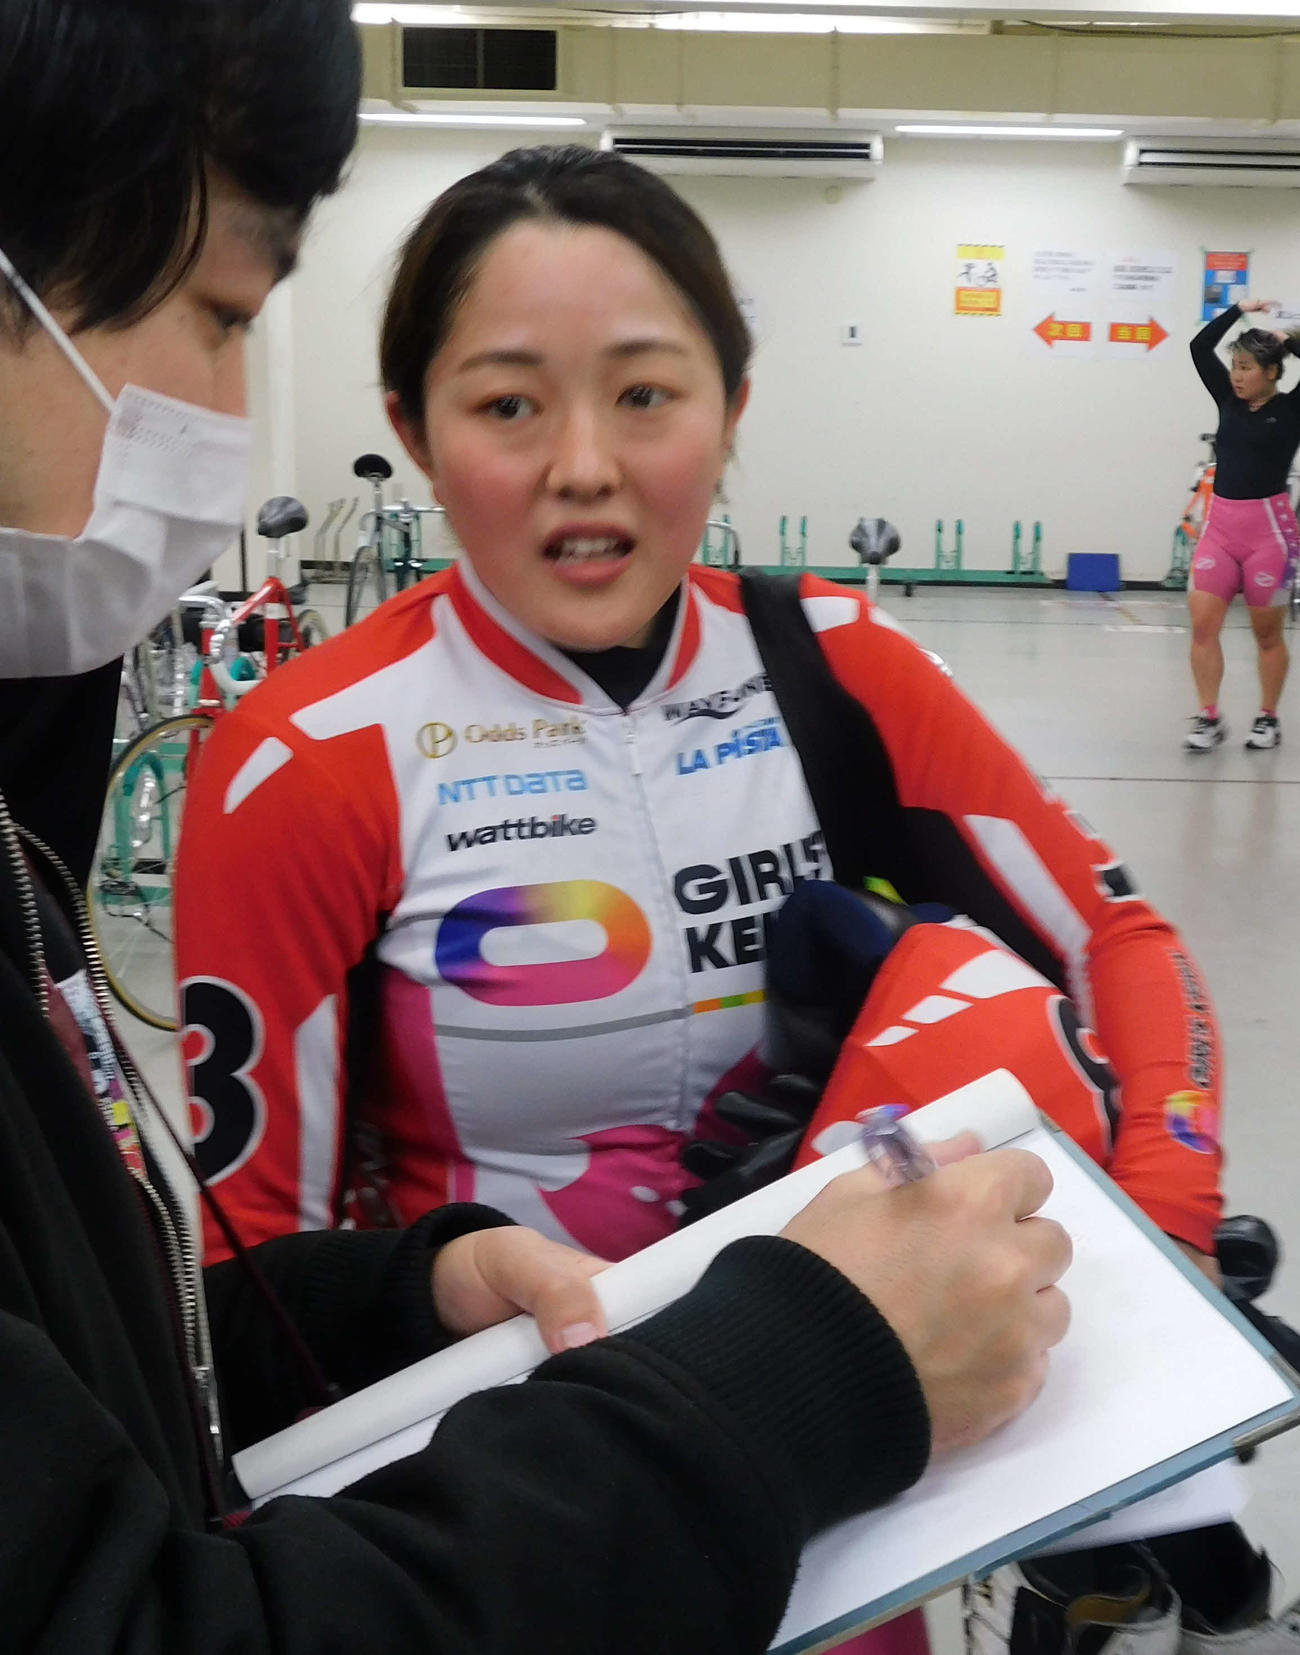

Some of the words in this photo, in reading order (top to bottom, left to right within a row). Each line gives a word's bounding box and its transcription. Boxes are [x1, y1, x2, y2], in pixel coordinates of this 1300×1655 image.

[676, 749, 711, 775] LA
[438, 775, 498, 805] NTT
[447, 814, 598, 851] wattbike
